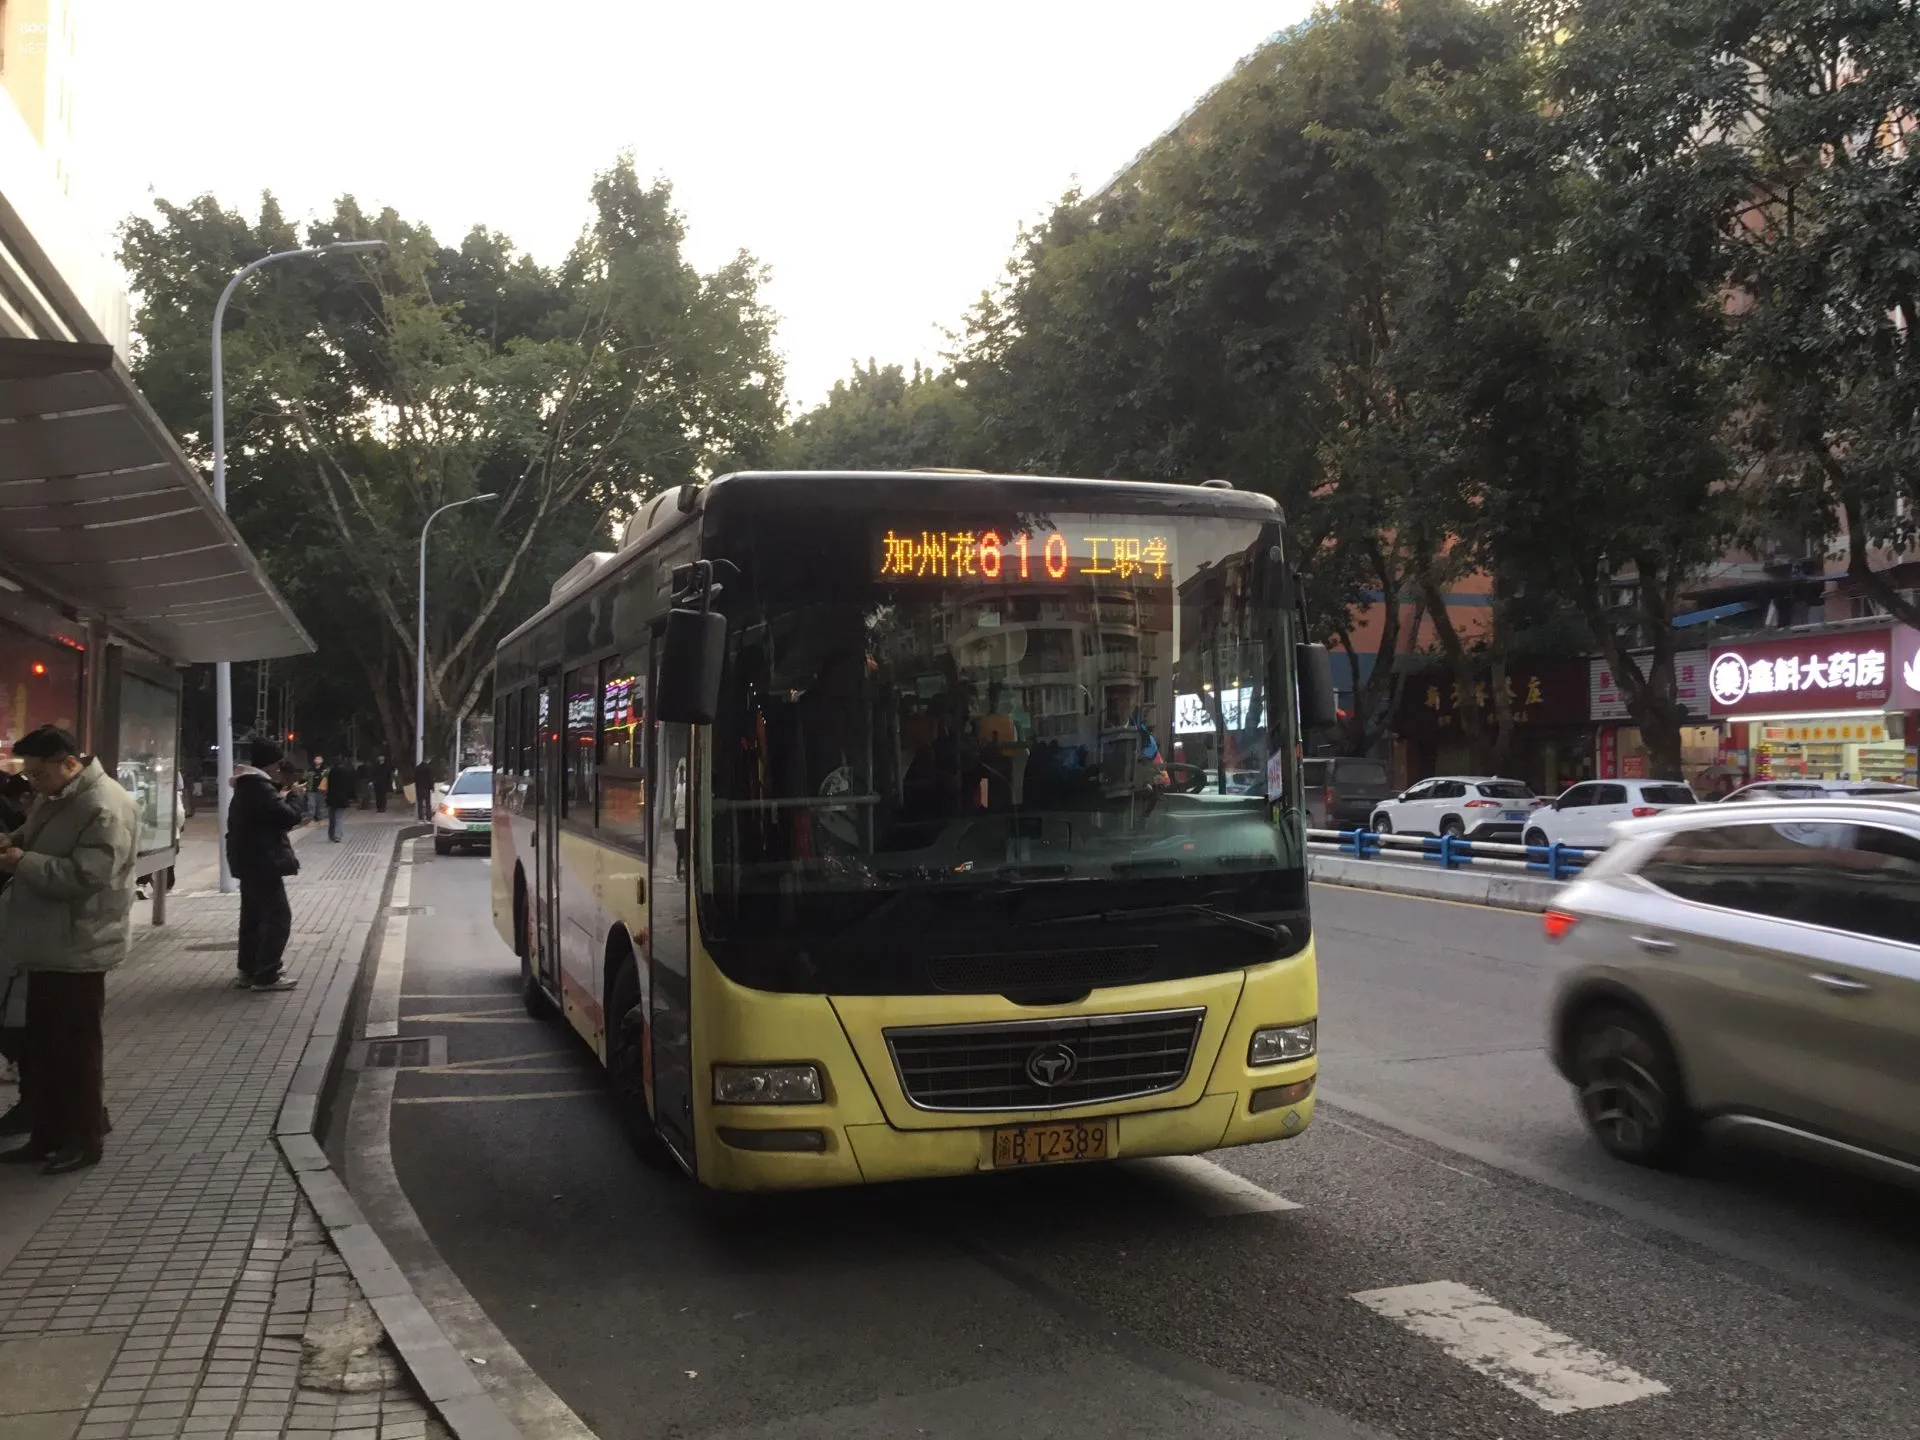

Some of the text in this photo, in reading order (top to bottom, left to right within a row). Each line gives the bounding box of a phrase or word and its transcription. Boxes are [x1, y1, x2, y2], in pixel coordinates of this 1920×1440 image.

[881, 530, 1167, 579] 加州花 610 工职学
